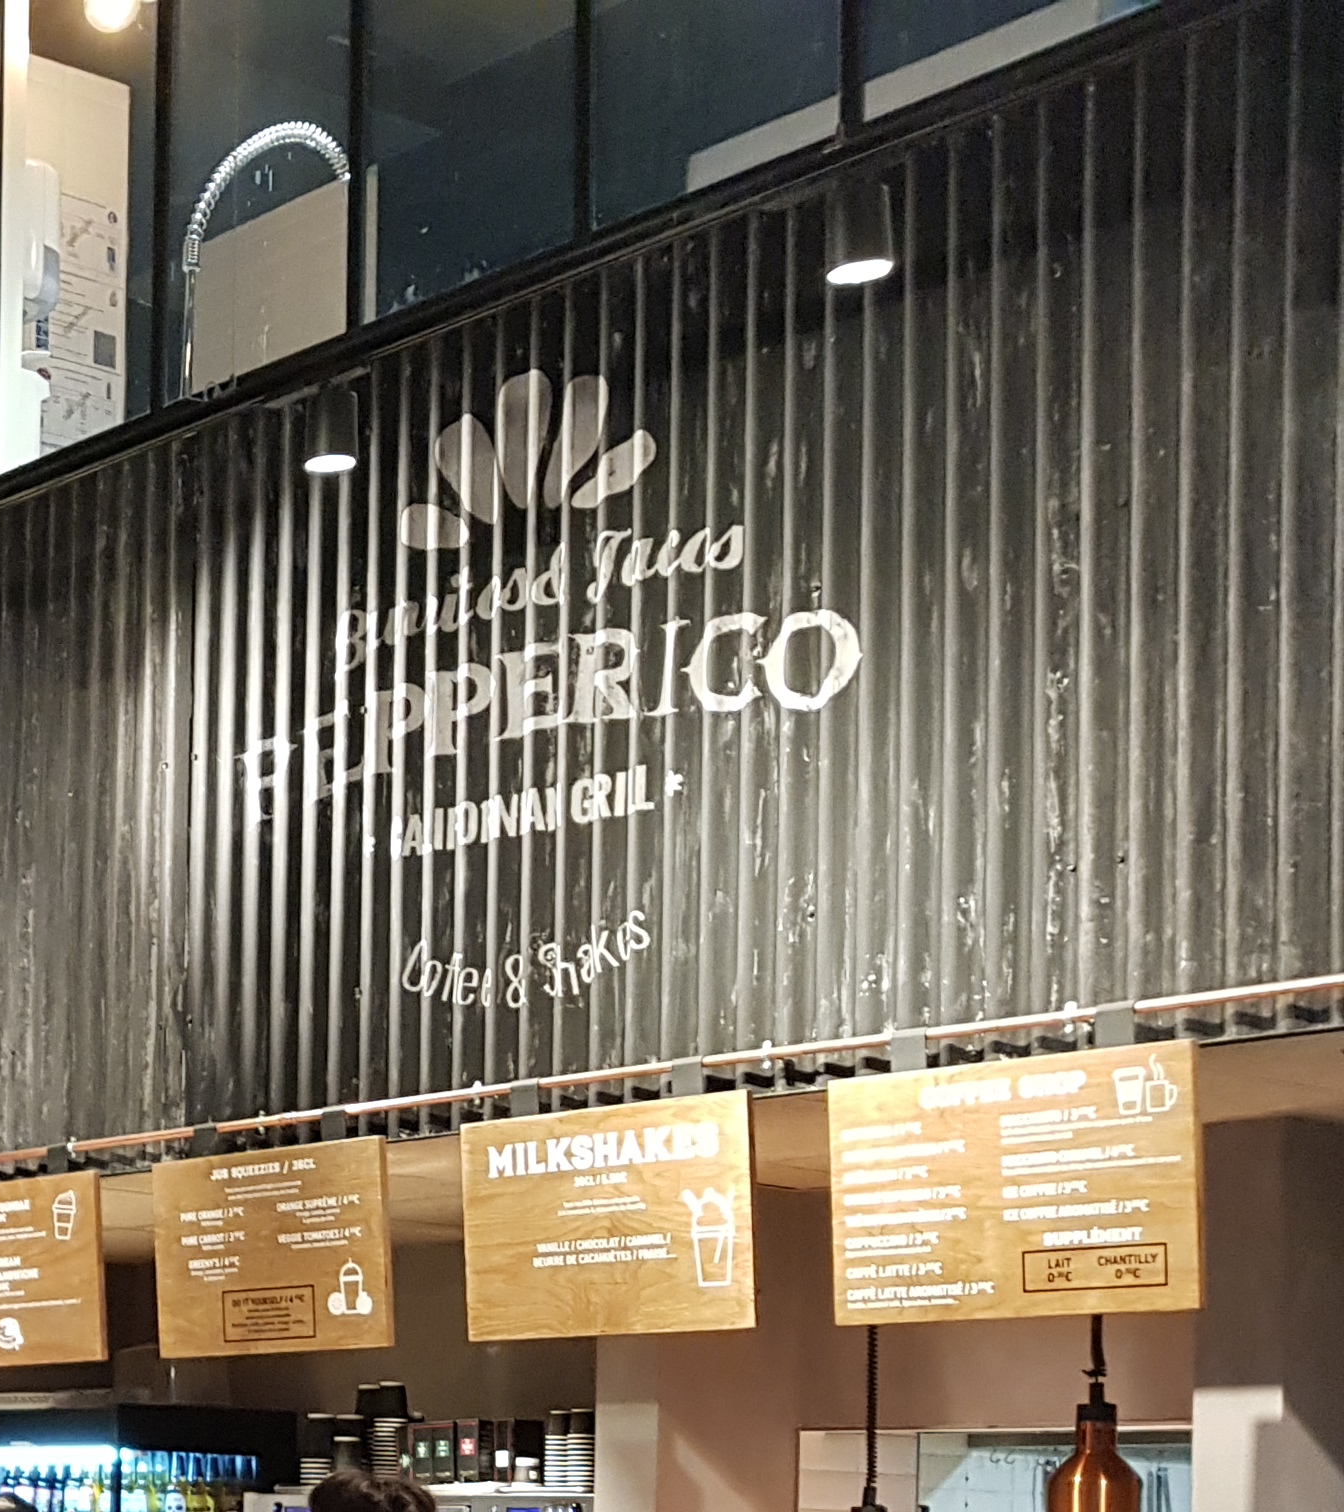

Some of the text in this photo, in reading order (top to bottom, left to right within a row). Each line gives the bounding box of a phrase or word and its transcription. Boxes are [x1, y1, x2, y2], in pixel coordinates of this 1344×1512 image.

[237, 608, 864, 828] PEPPERICO
[537, 910, 652, 998] Shakes
[486, 1121, 720, 1180] MILKSHAKES
[1047, 1253, 1159, 1270] LAIT CHANTILLY
